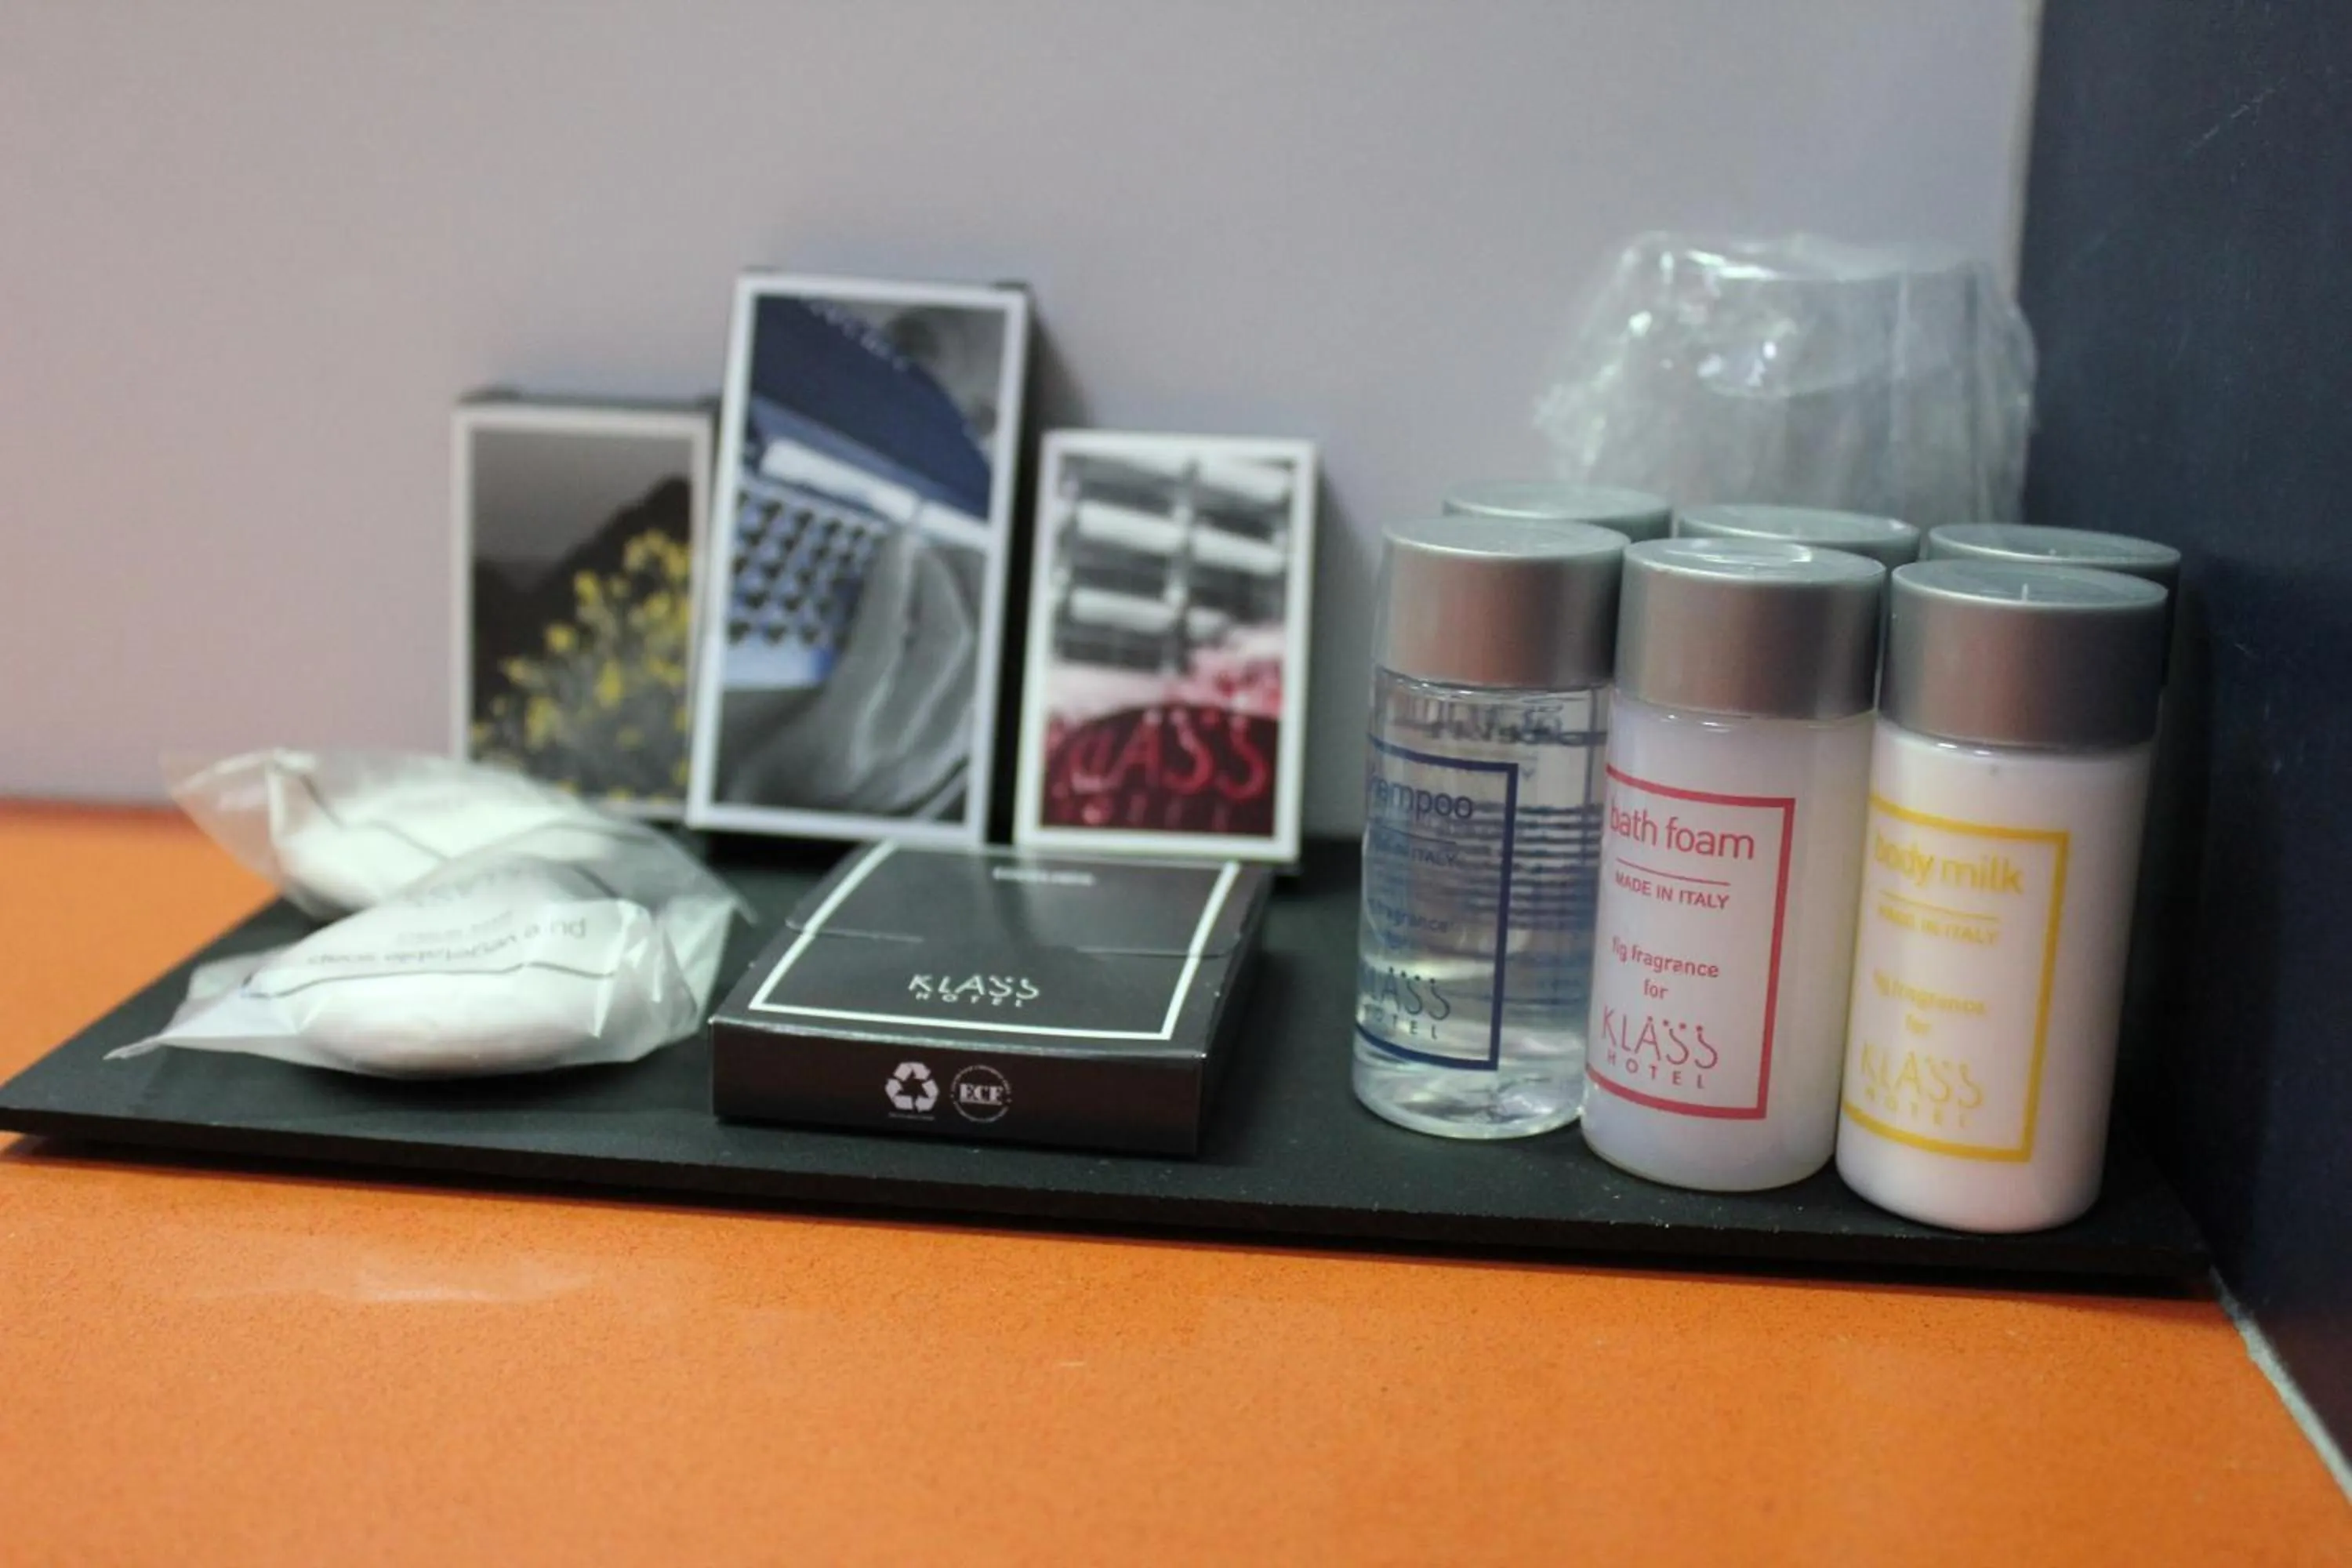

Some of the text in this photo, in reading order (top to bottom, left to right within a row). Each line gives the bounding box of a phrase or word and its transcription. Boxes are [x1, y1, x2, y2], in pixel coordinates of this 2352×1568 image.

[1610, 798, 1755, 861] bath foam
[1615, 870, 1730, 911] MADE IN ITALY
[1940, 853, 2024, 896] milk
[1612, 936, 1720, 978] fig fragrance
[1643, 978, 1669, 1000] for
[1607, 1051, 1706, 1091] HOTEL
